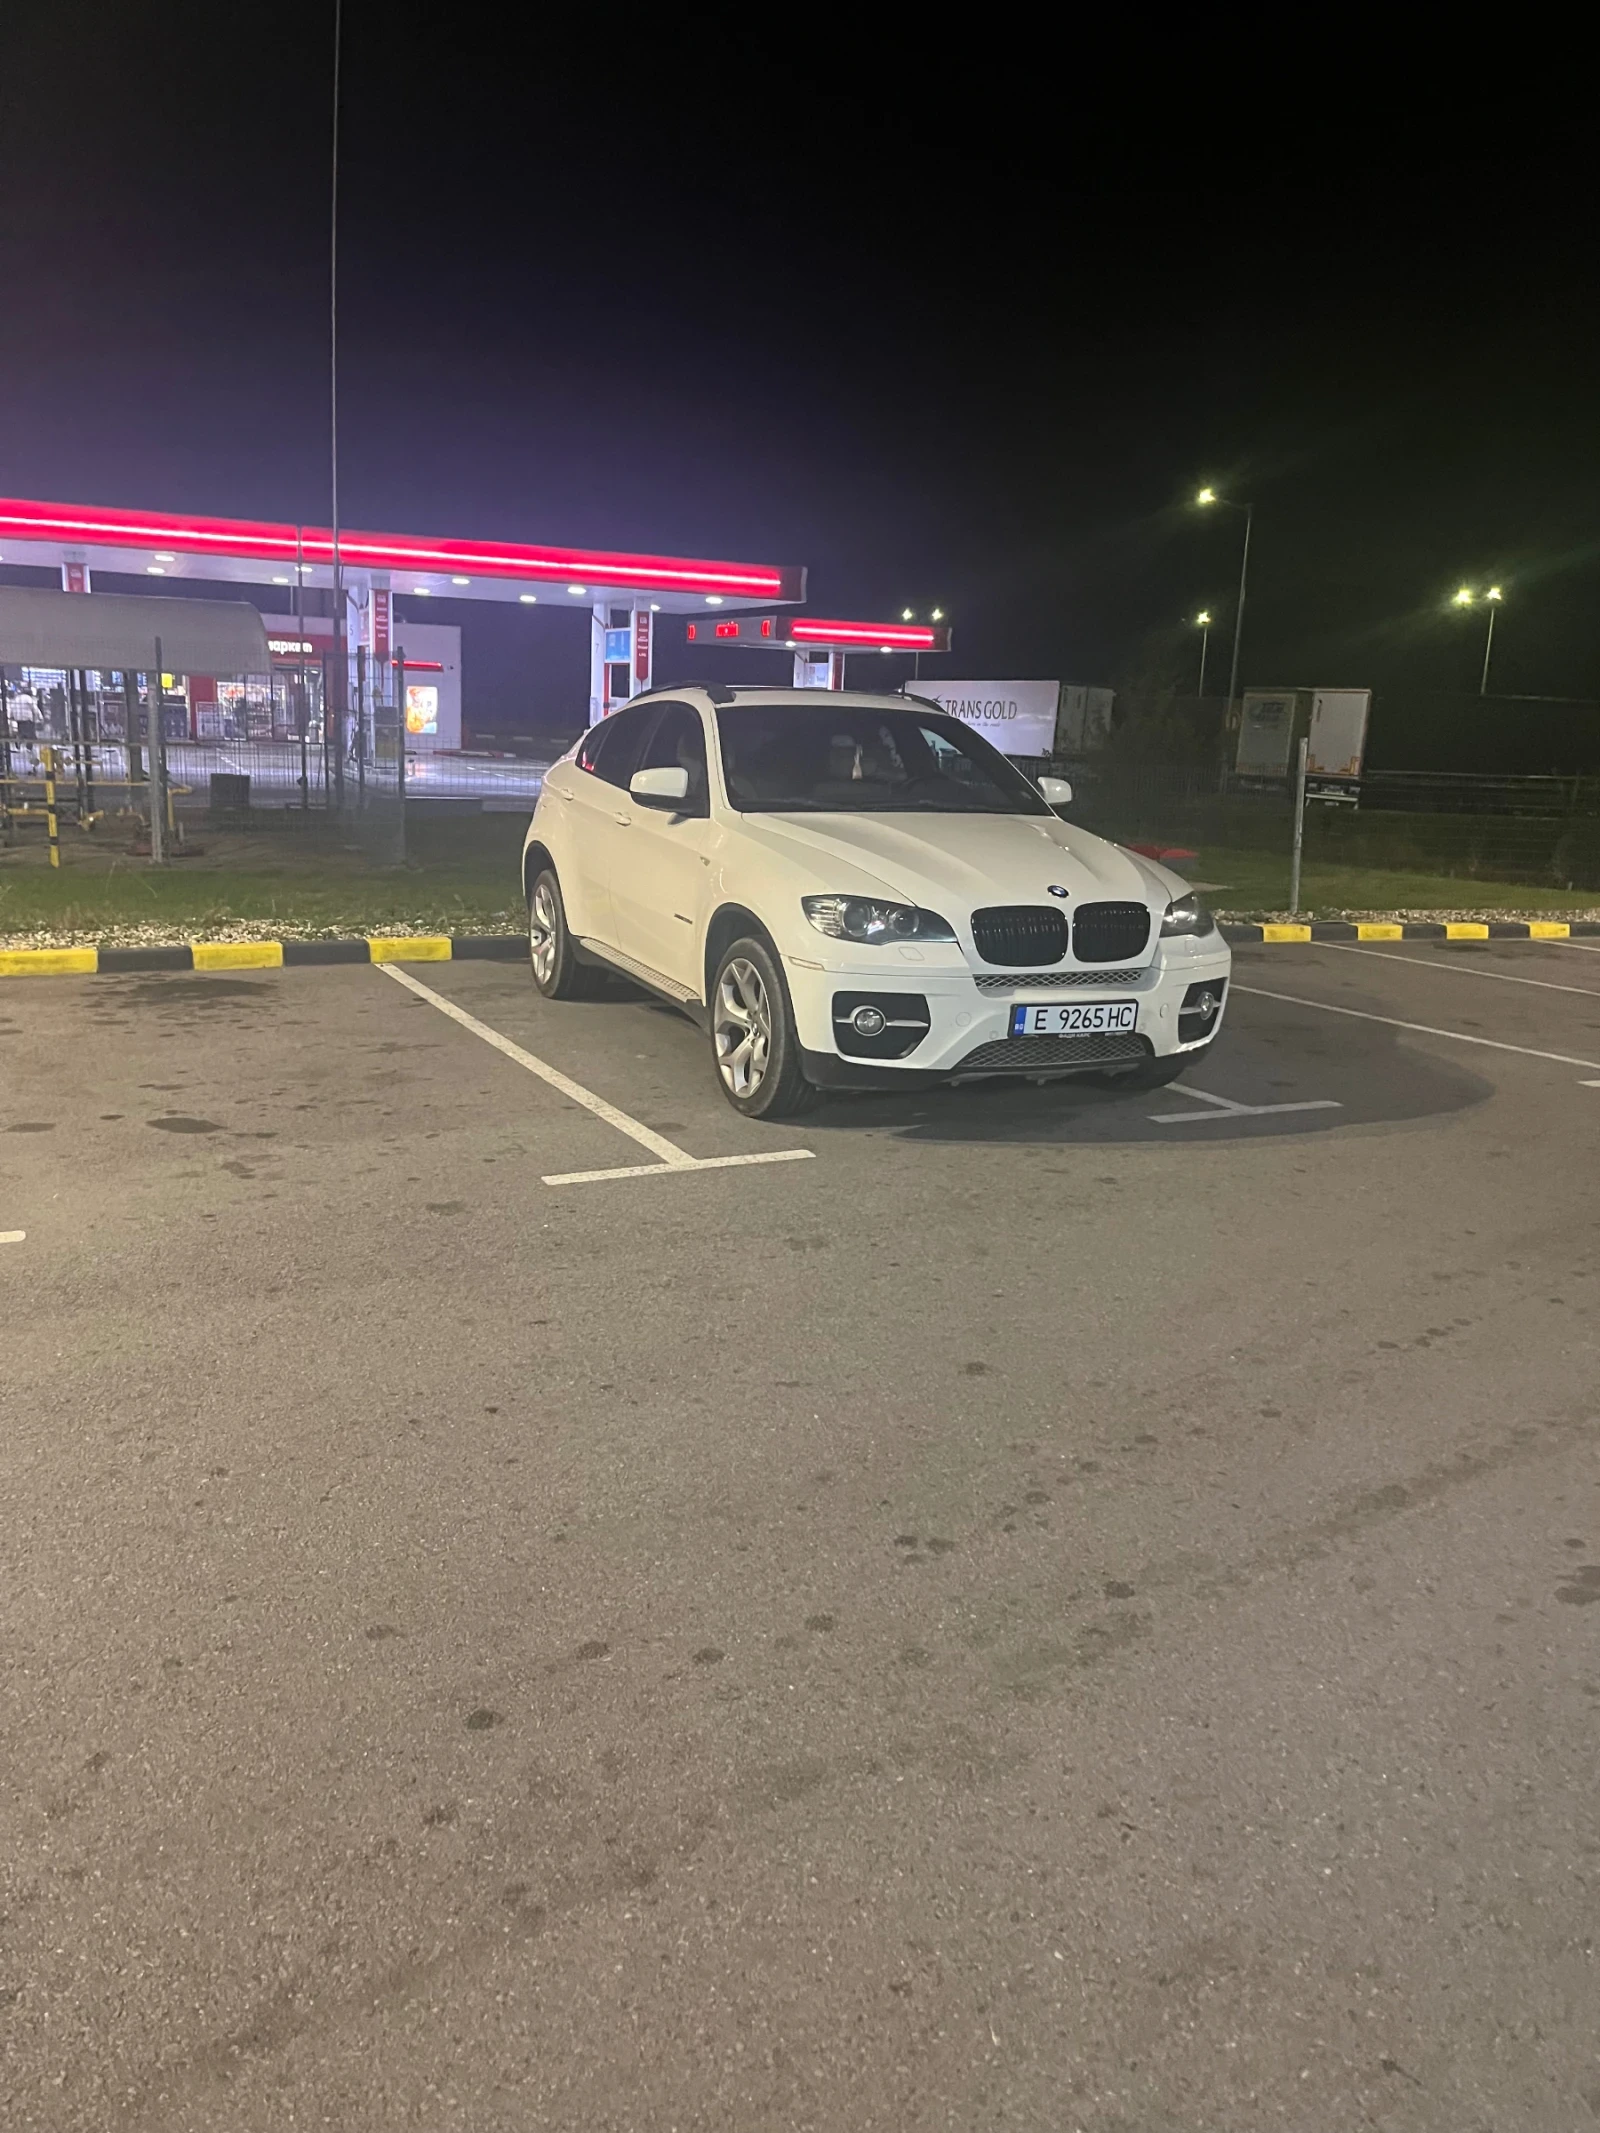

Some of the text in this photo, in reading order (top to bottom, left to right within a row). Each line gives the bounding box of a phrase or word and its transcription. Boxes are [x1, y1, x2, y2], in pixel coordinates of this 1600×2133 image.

[946, 700, 1017, 719] TRANS GOLD
[1034, 1007, 1132, 1030] E 9265 HC
